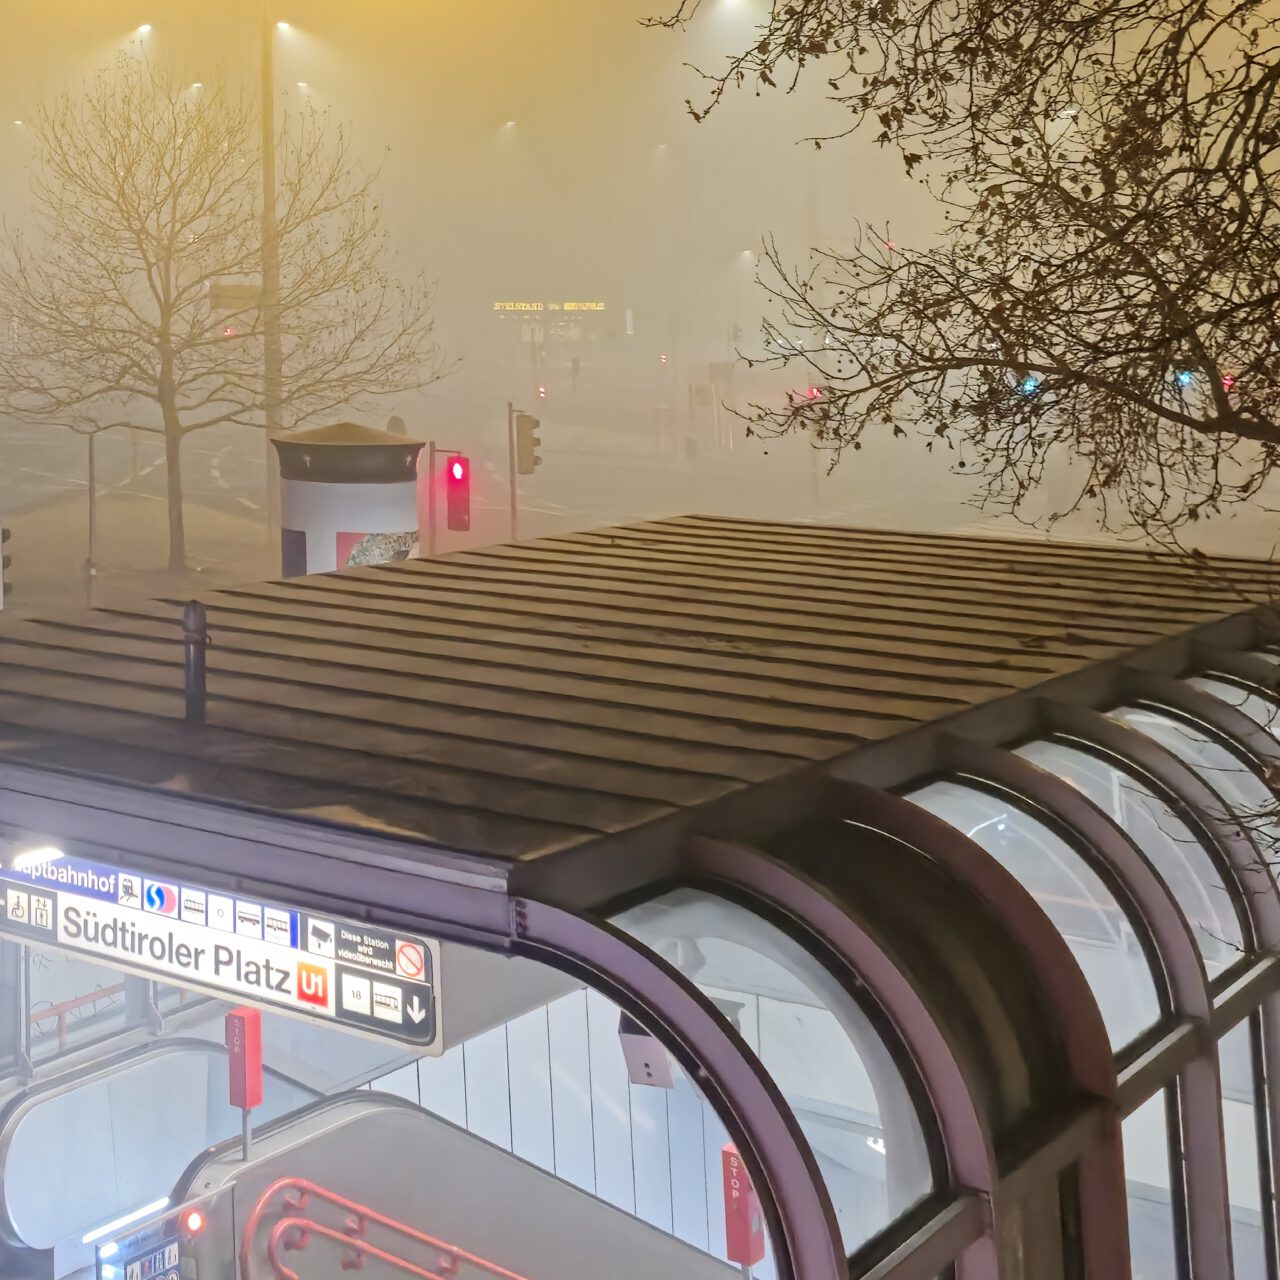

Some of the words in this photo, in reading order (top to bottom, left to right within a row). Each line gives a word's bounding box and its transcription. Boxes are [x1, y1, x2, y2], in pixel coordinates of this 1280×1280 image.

[341, 929, 362, 943] Diese
[363, 934, 390, 950] Station
[357, 943, 374, 956] wird
[63, 906, 206, 971] Südtiroler
[213, 944, 292, 996] Platz
[301, 969, 324, 998] U1
[337, 947, 395, 971] videoüberwacht
[351, 989, 362, 1001] 18
[730, 1156, 741, 1199] STOP
